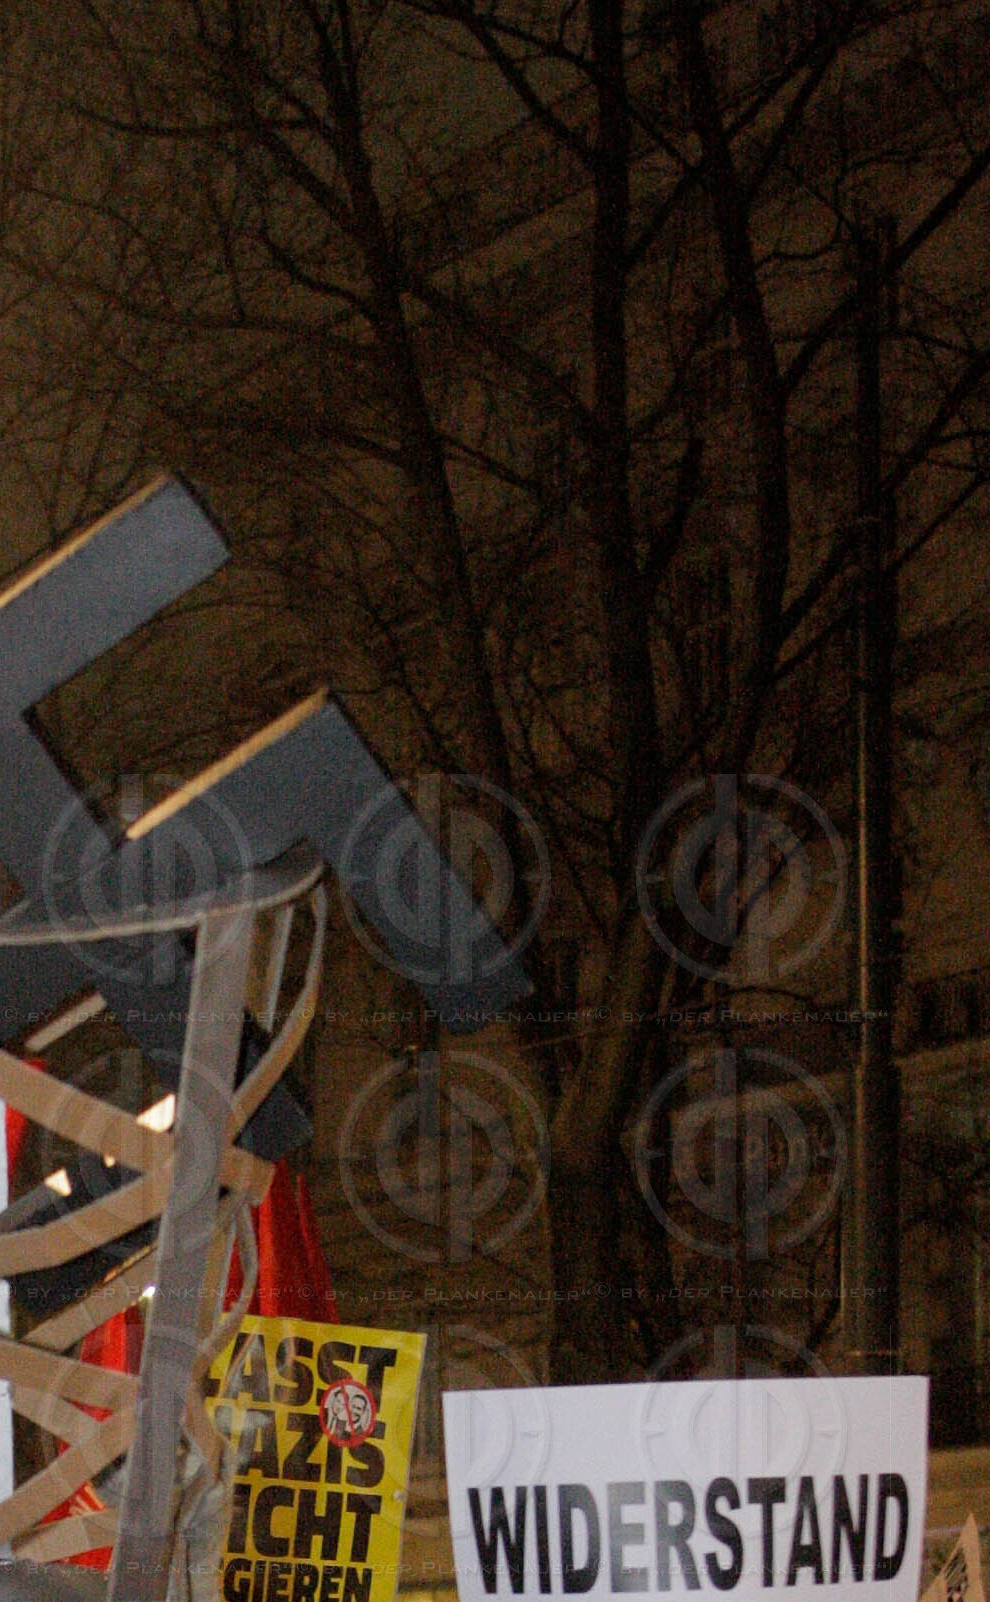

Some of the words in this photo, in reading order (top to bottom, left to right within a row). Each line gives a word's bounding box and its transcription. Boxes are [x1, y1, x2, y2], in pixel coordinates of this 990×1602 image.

[202, 1333, 397, 1413] ASST
[226, 1483, 382, 1562] ICHT
[467, 1473, 909, 1594] WIDERSTAND
